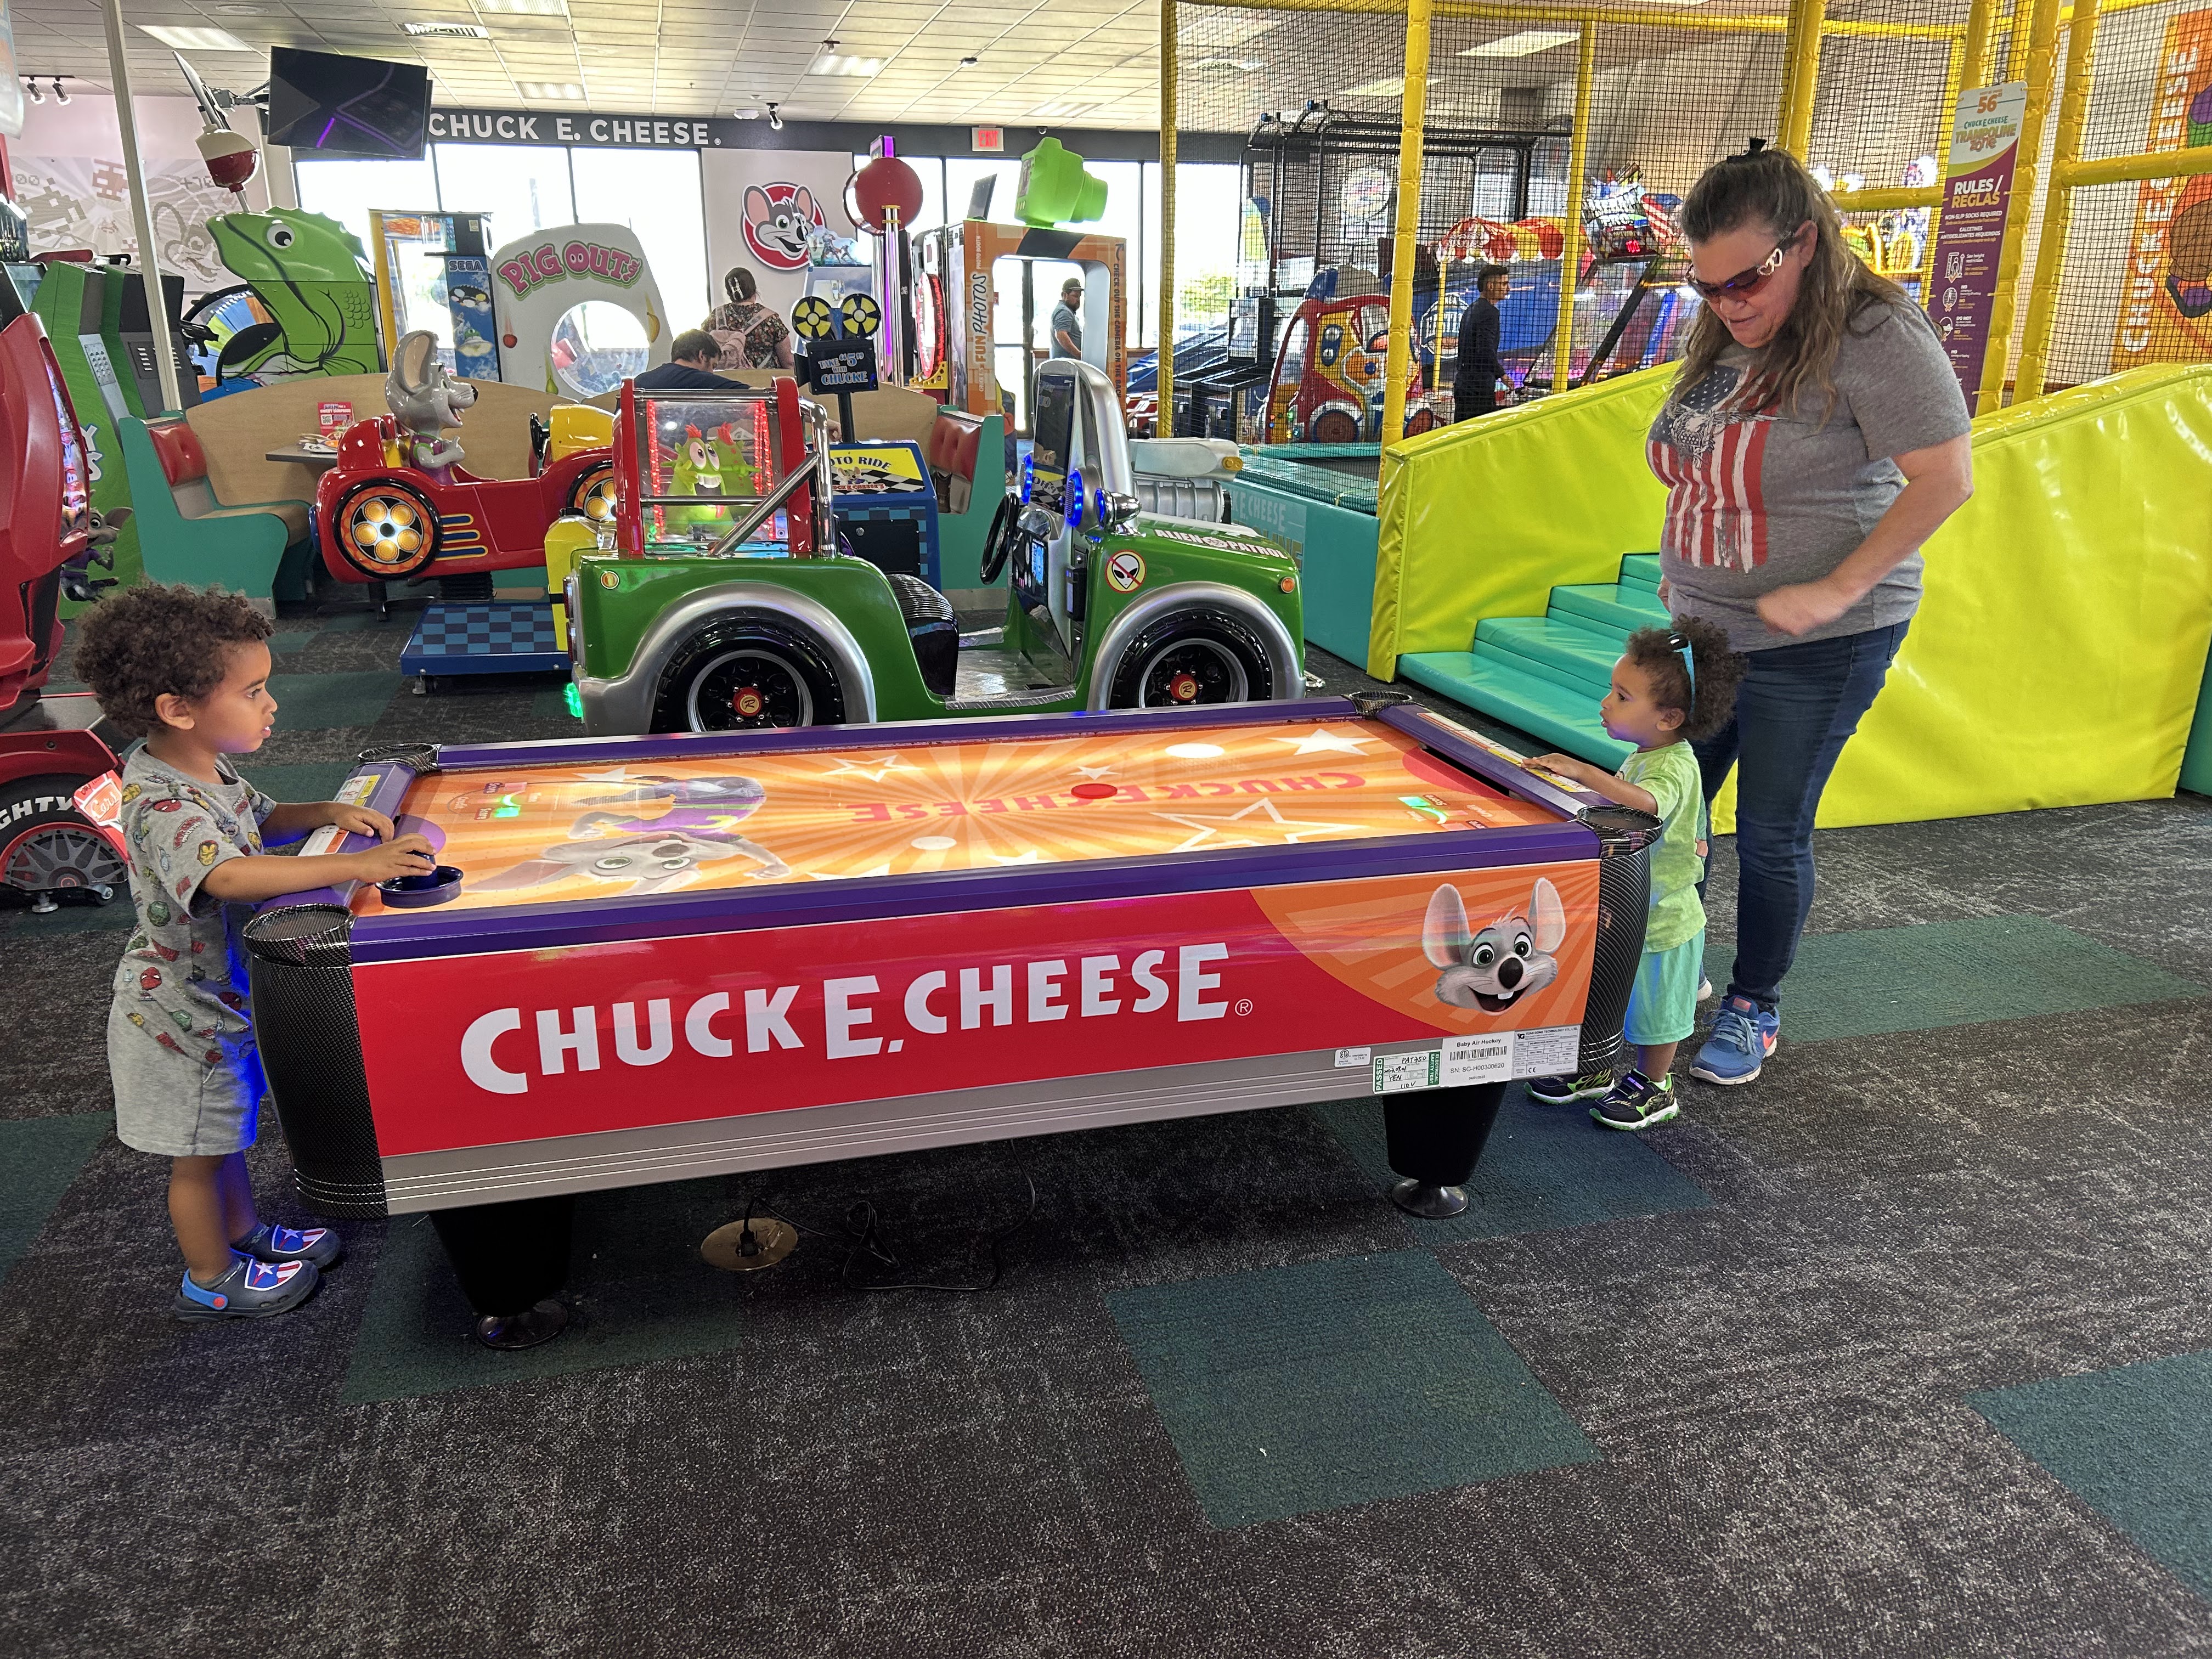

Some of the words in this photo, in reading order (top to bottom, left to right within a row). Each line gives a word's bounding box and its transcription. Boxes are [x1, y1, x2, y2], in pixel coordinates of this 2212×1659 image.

[428, 113, 539, 139] CHUCK
[556, 118, 581, 140] E.
[590, 120, 709, 145] CHEESE
[1964, 119, 1982, 129] CHUCK
[1987, 116, 2008, 125] CHEESE
[978, 130, 998, 148] EXIT
[1956, 123, 2017, 144] TRAMPOLINE
[1951, 191, 2000, 208] REGLAS
[449, 260, 483, 272] SEGA
[498, 244, 565, 297] PIG
[972, 273, 988, 335] PHOTOS
[975, 336, 986, 363] FUN
[1115, 352, 1121, 363] ON
[818, 358, 840, 370] TAKE
[859, 456, 893, 471] RIDE
[1248, 495, 1286, 532] CHEESE
[1154, 529, 1204, 544] ALIEN
[1226, 540, 1288, 559] PATROL
[1155, 772, 1366, 799] CHUCK
[91, 792, 118, 819] Cars
[460, 985, 804, 1094] CHUCK
[823, 974, 905, 1060] E.
[903, 942, 1229, 1035] CHEESE
[1389, 1074, 1402, 1082] YEN
[1462, 1062, 1504, 1073] SG-H00300620
